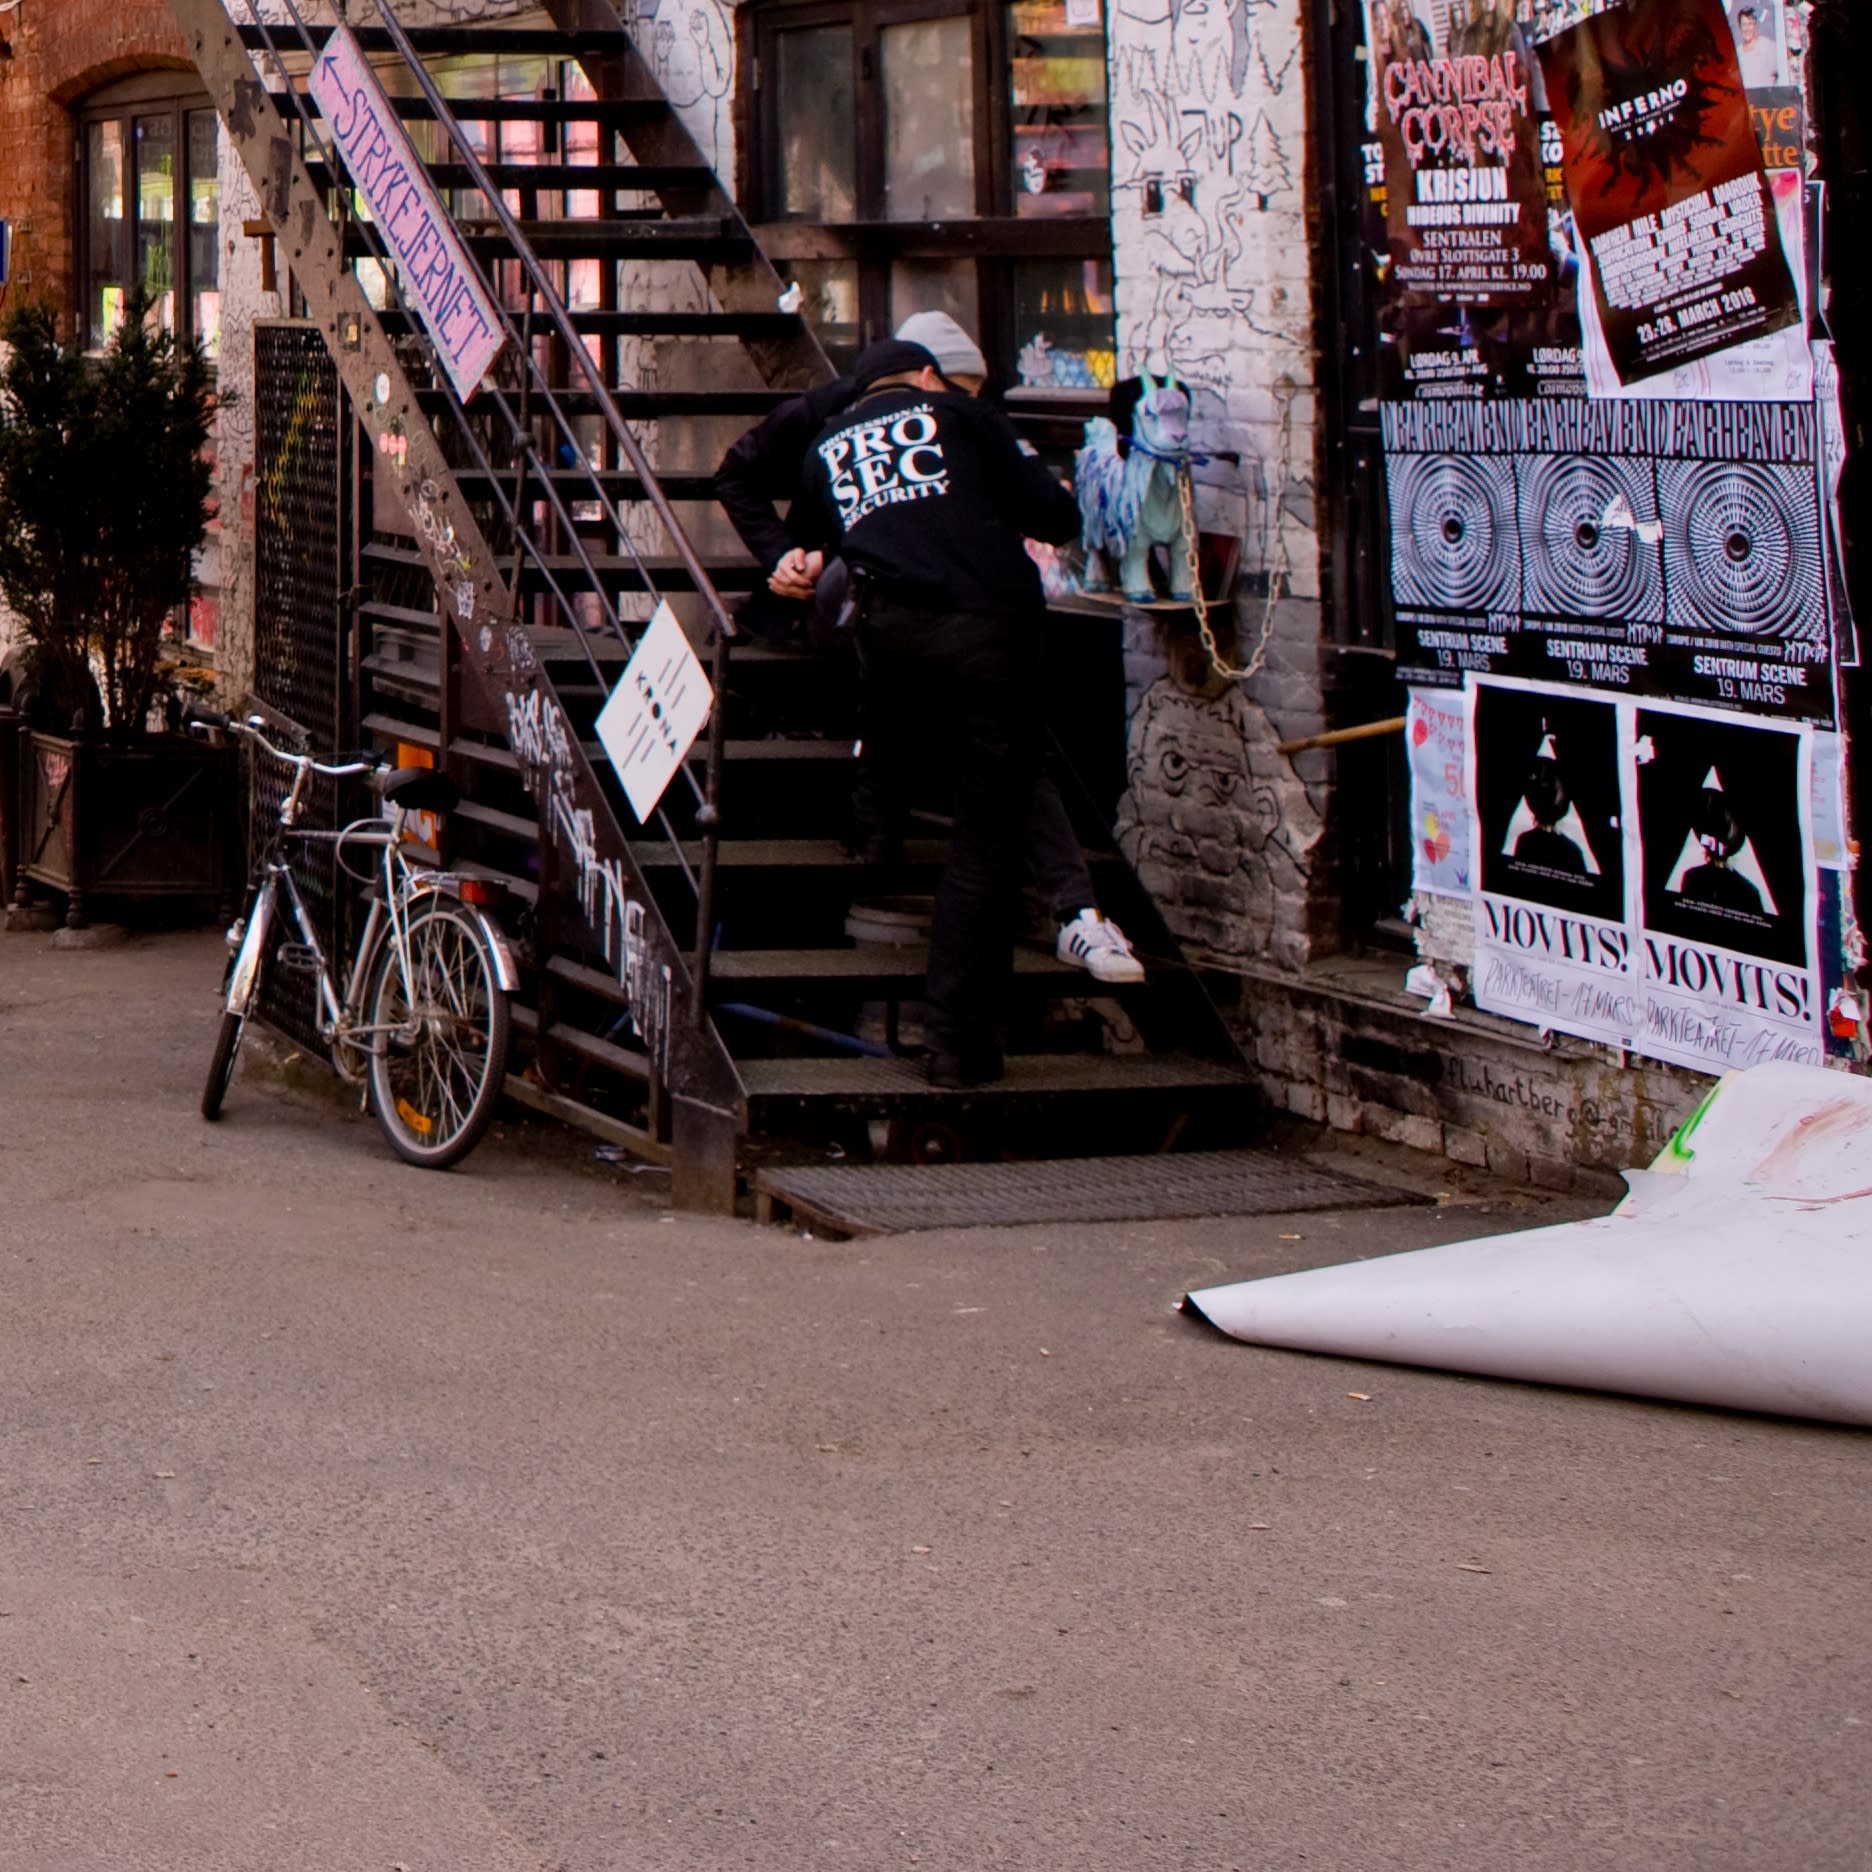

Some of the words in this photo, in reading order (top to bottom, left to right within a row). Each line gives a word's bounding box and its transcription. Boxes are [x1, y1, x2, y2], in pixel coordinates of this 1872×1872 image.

[1384, 51, 1527, 120] CANNIBAL
[1598, 78, 1688, 130] INFERNO
[1401, 101, 1516, 164] CORPSE
[1423, 230, 1502, 248] SENTRALEN
[1438, 264, 1456, 280] 17.
[1456, 264, 1489, 279] APRIL
[1512, 263, 1547, 280] 19.00
[1440, 248, 1509, 264] SLOTTSGATE
[1511, 247, 1520, 263] 3
[1677, 297, 1722, 329] MARCH
[1721, 286, 1756, 313] 2016
[1532, 347, 1575, 364] LØRDAG
[823, 413, 937, 483] PRO
[832, 443, 948, 519] SEC
[843, 479, 950, 532] SECURITY
[1417, 629, 1470, 650] SENTRUM
[1470, 632, 1509, 654] SCENE
[1546, 639, 1608, 662] SENTRUM
[1608, 644, 1649, 666] SCENE
[1436, 649, 1456, 668] 19.
[1457, 651, 1492, 672] MARS
[1566, 659, 1588, 680] 19.
[1591, 662, 1630, 684] MARS
[1693, 655, 1758, 680] SENTRUM
[1760, 663, 1808, 687] SCENE
[1716, 677, 1738, 700] 19.
[1740, 682, 1786, 705] MARS
[635, 671, 678, 756] KRONA
[1483, 899, 1630, 973] MOVITS!
[1644, 937, 1813, 1022] MOVITS!
[1571, 986, 1590, 1015] 17
